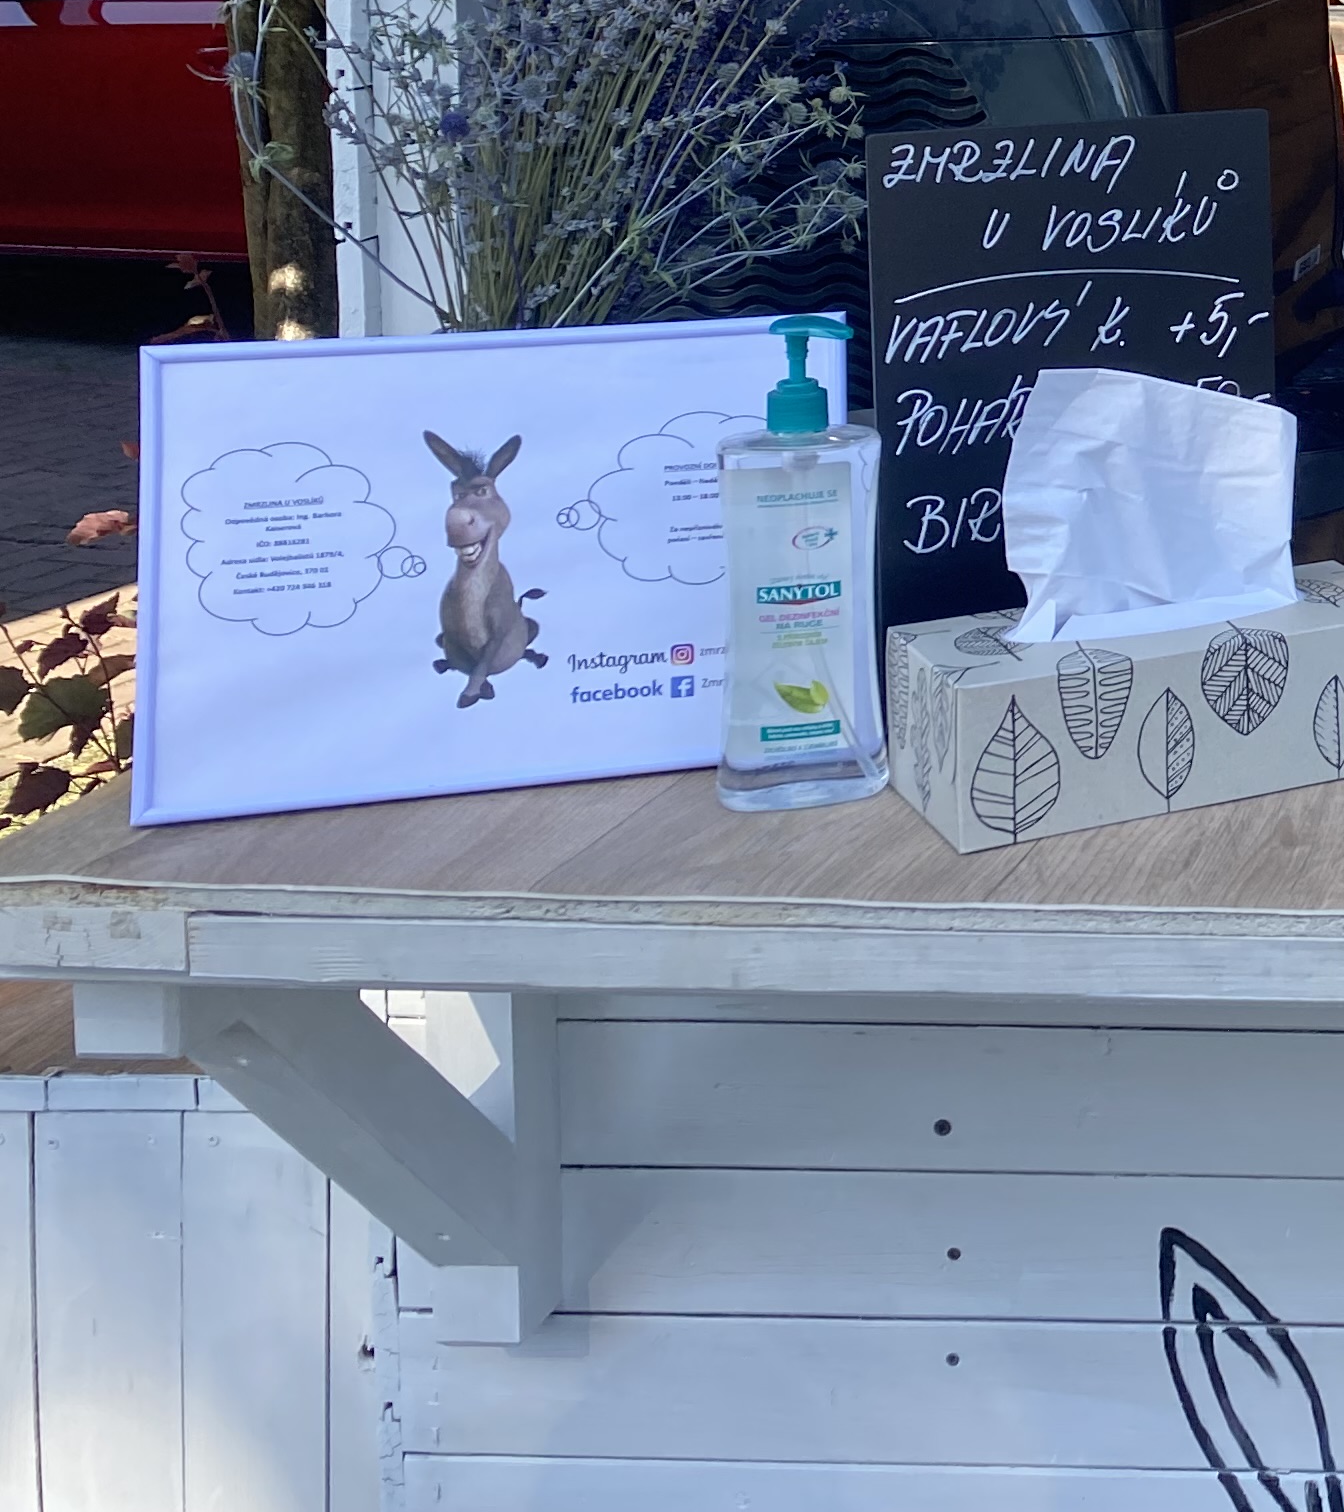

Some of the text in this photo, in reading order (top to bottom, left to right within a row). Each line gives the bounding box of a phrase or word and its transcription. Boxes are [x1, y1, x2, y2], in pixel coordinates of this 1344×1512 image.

[883, 135, 1137, 194] ZMRZLINA
[982, 208, 1012, 252] U
[758, 583, 840, 603] SANYTOL
[567, 651, 667, 674] Instagram
[570, 679, 663, 704] facebook
